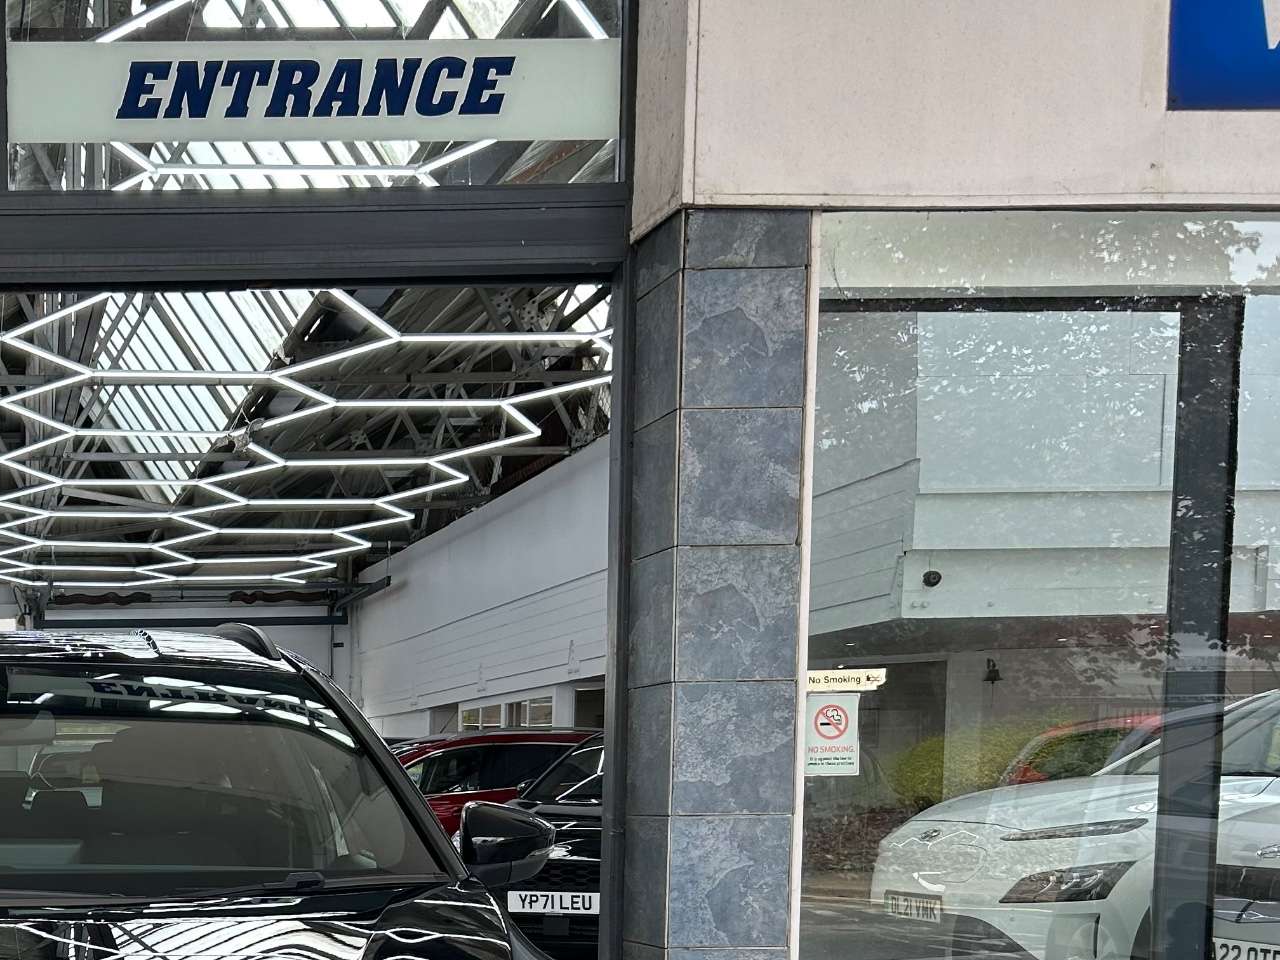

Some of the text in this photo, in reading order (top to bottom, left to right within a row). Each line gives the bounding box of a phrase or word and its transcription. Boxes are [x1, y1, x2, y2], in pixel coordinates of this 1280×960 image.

[116, 56, 516, 119] ENTRANCE
[808, 675, 861, 685] No Smoking
[807, 745, 819, 754] NO
[518, 893, 592, 911] YP71 LEU
